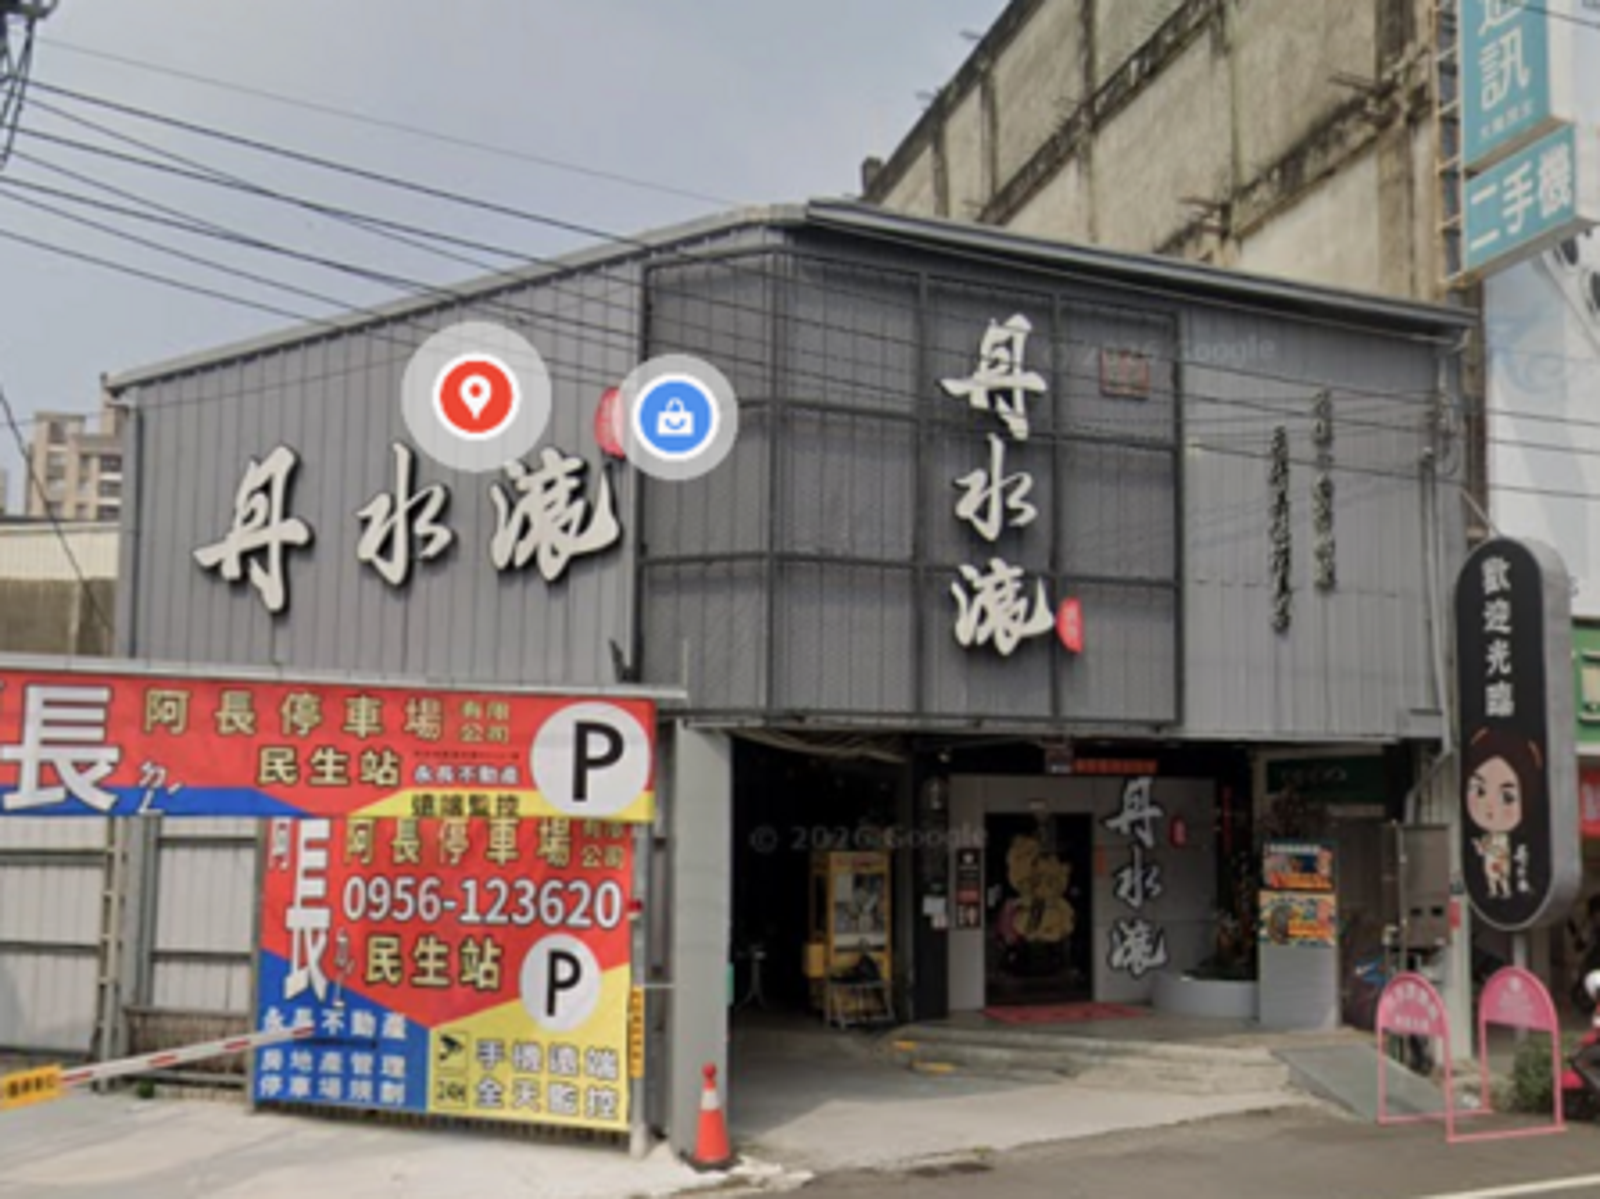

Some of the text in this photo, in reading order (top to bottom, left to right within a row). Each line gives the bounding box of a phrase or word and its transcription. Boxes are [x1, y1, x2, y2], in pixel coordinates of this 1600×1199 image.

[1481, 556, 1515, 718] 歡迎光臨
[256, 745, 400, 787] 民生站
[572, 720, 625, 802] P
[342, 875, 623, 929] 0956-123620
[365, 935, 502, 991] 民生站
[547, 949, 583, 1017] P
